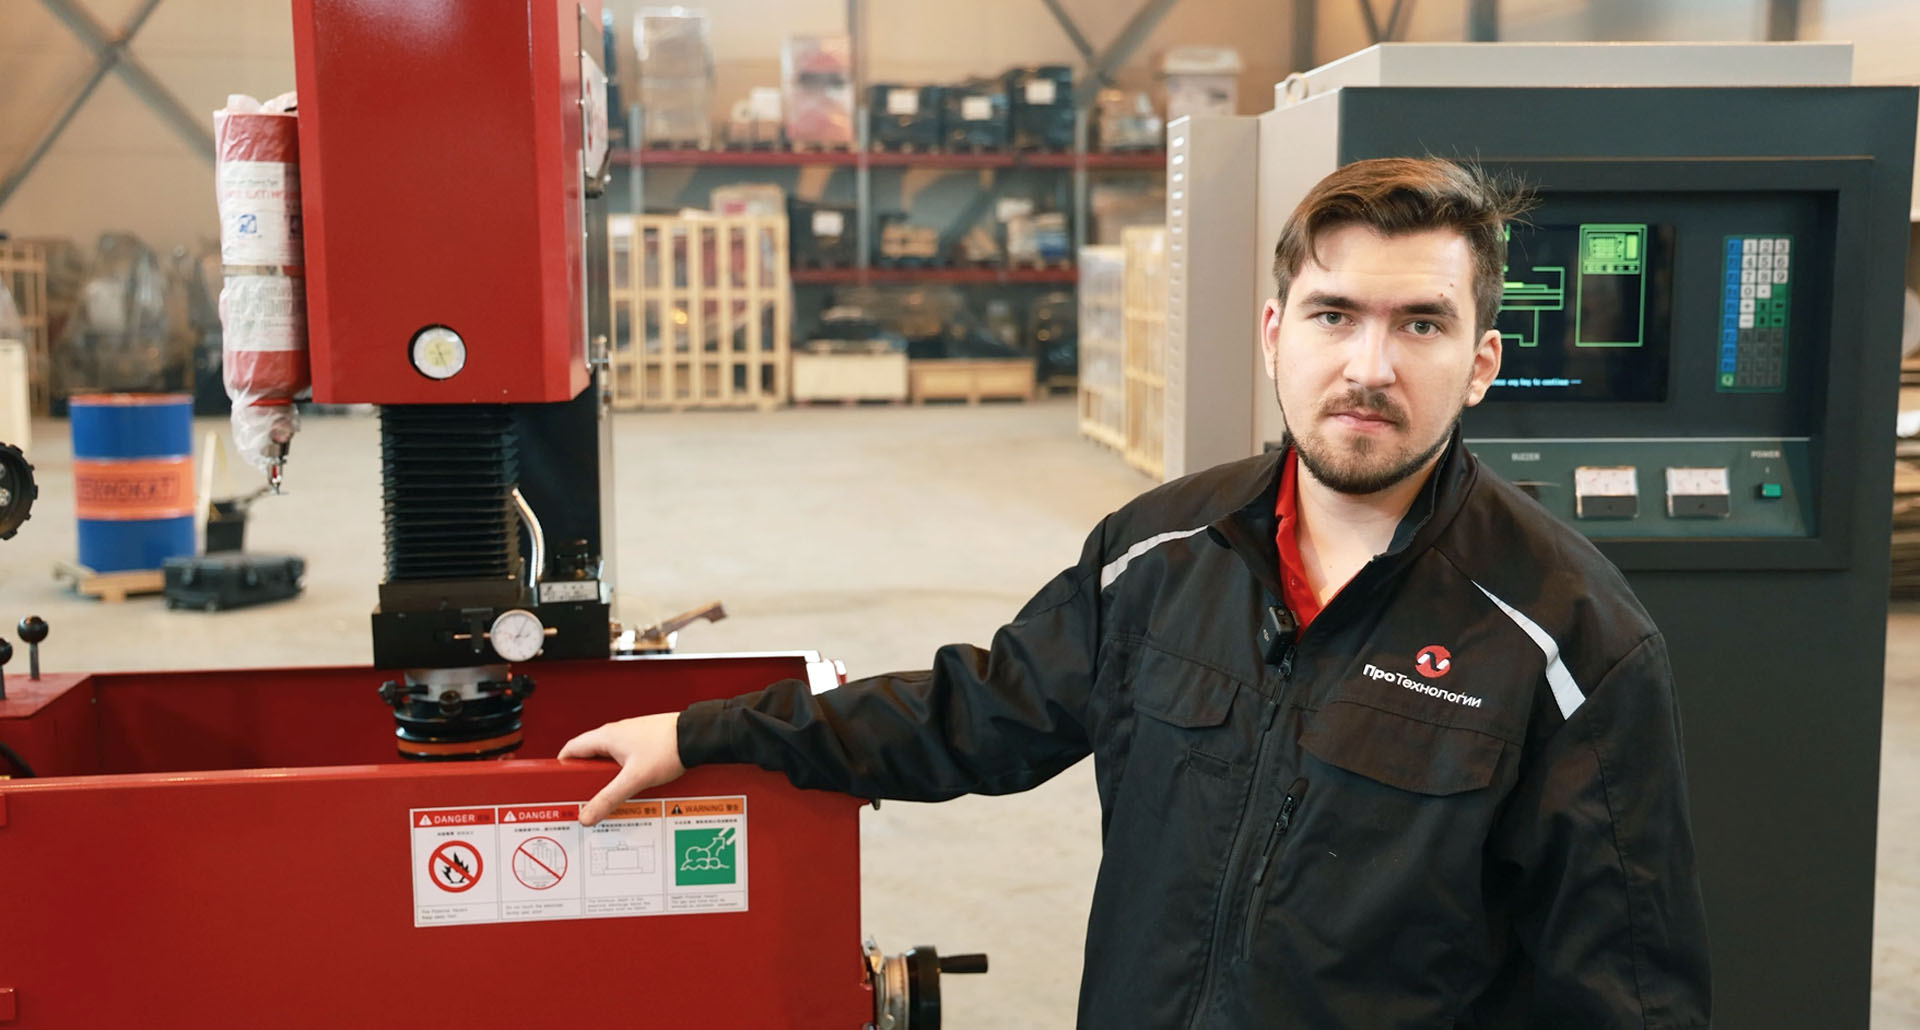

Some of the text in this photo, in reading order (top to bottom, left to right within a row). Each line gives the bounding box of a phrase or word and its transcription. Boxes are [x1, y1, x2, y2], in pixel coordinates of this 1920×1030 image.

[1751, 450, 1780, 459] POWER
[1363, 664, 1482, 708] ПроТехнологии
[685, 804, 724, 813] WARNING
[434, 814, 475, 824] DANGER
[518, 810, 560, 820] DANGER
